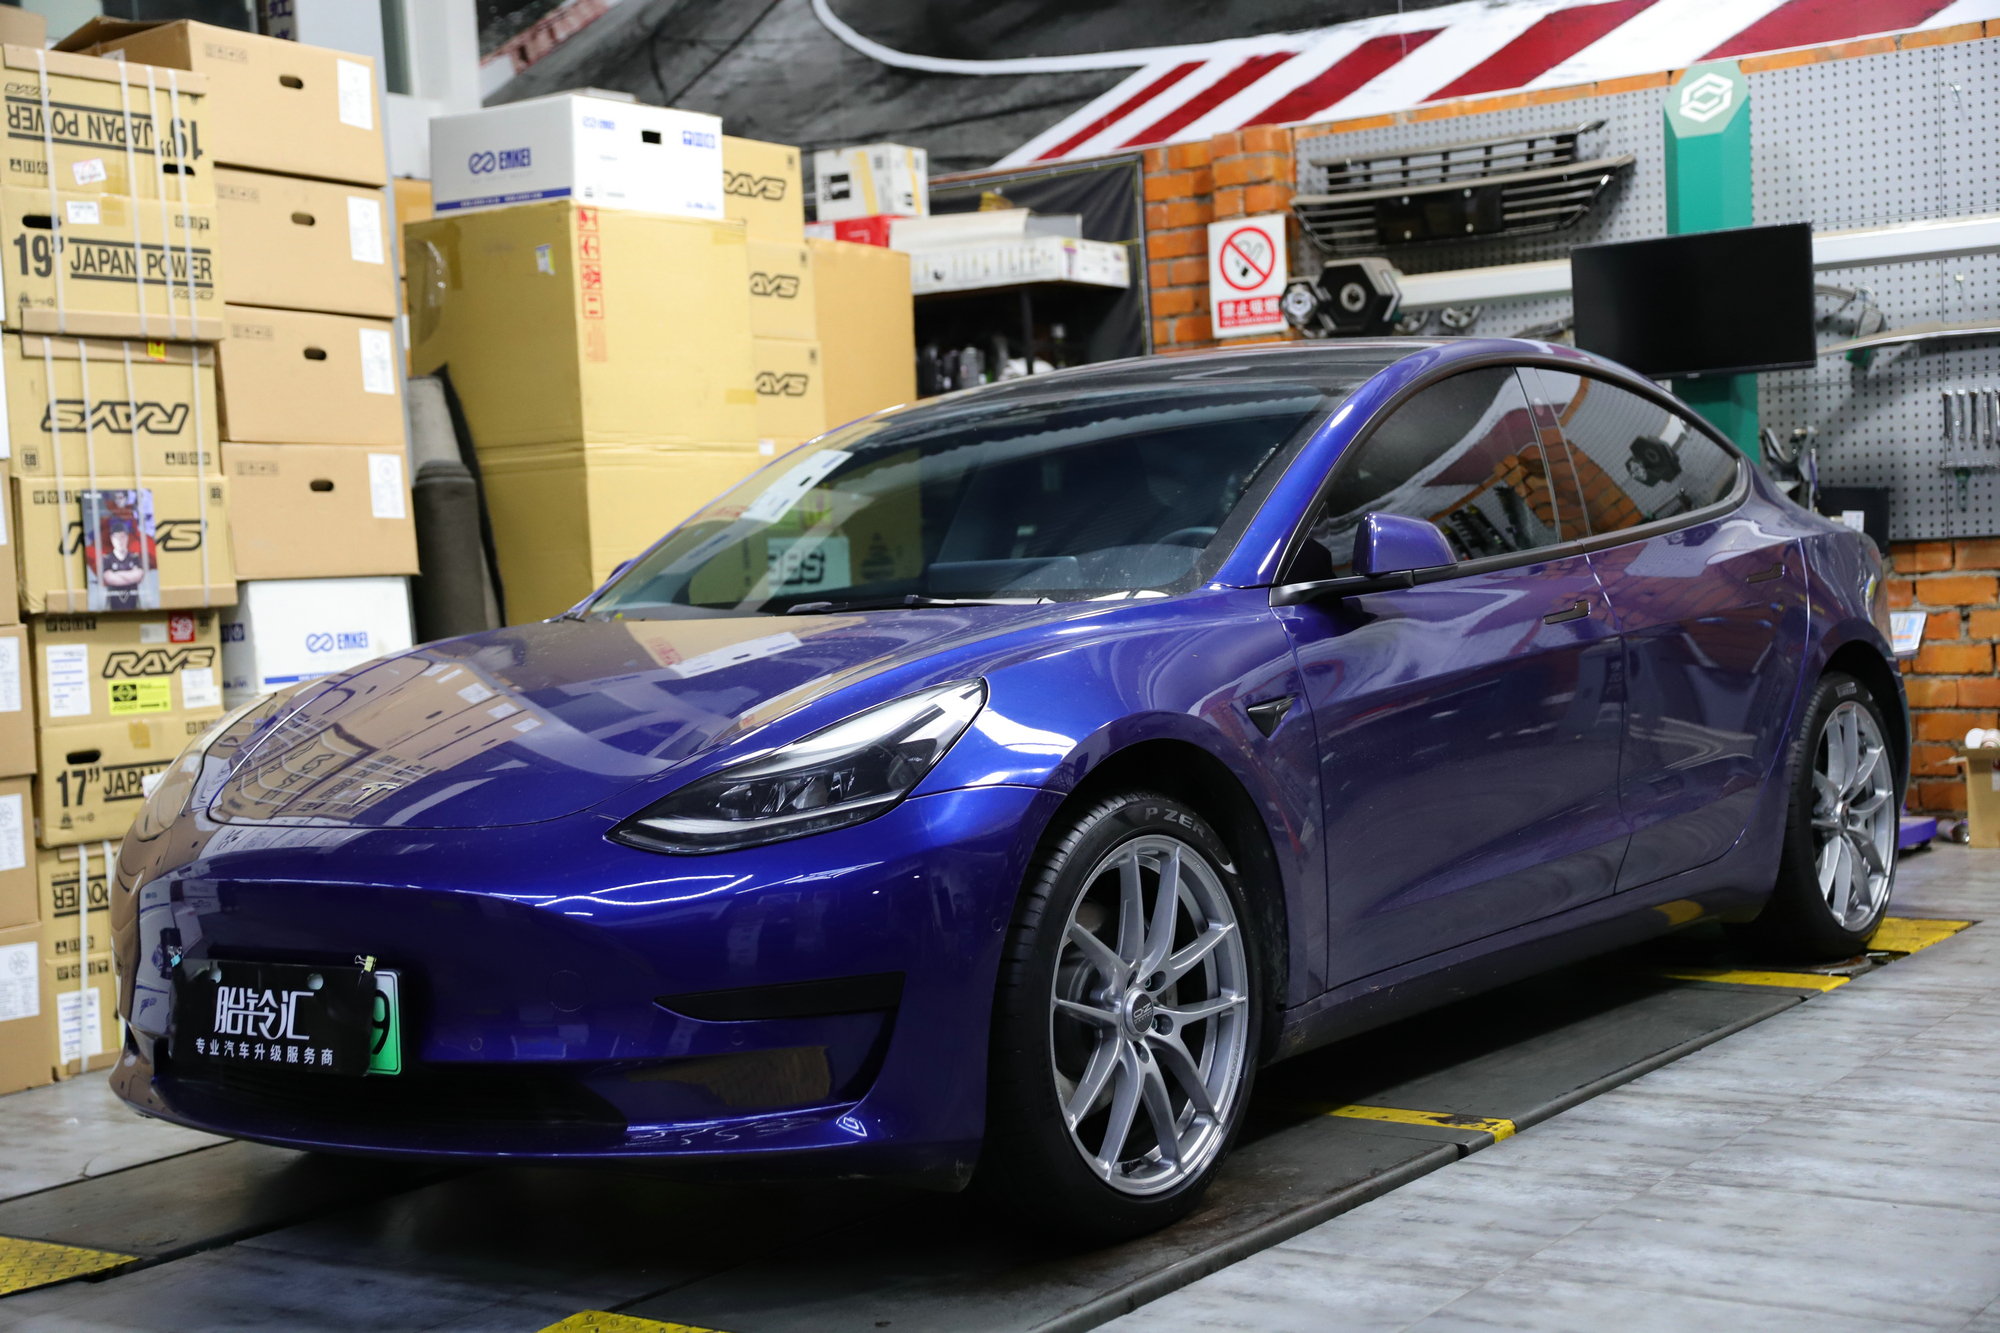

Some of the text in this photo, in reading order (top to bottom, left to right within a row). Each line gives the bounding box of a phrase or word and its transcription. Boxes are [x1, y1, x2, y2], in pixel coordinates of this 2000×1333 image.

[7, 104, 79, 137] POWER
[88, 114, 154, 146] JAPAN
[70, 246, 138, 275] JAPAN
[147, 253, 213, 280] POWER
[41, 399, 189, 435] RAYS
[102, 647, 215, 679] RAYS
[1144, 806, 1212, 843] P ZER
[53, 882, 109, 910] OER
[213, 986, 315, 1041] 胎铃汇
[195, 1037, 334, 1067] 专业汽车升级服务商
